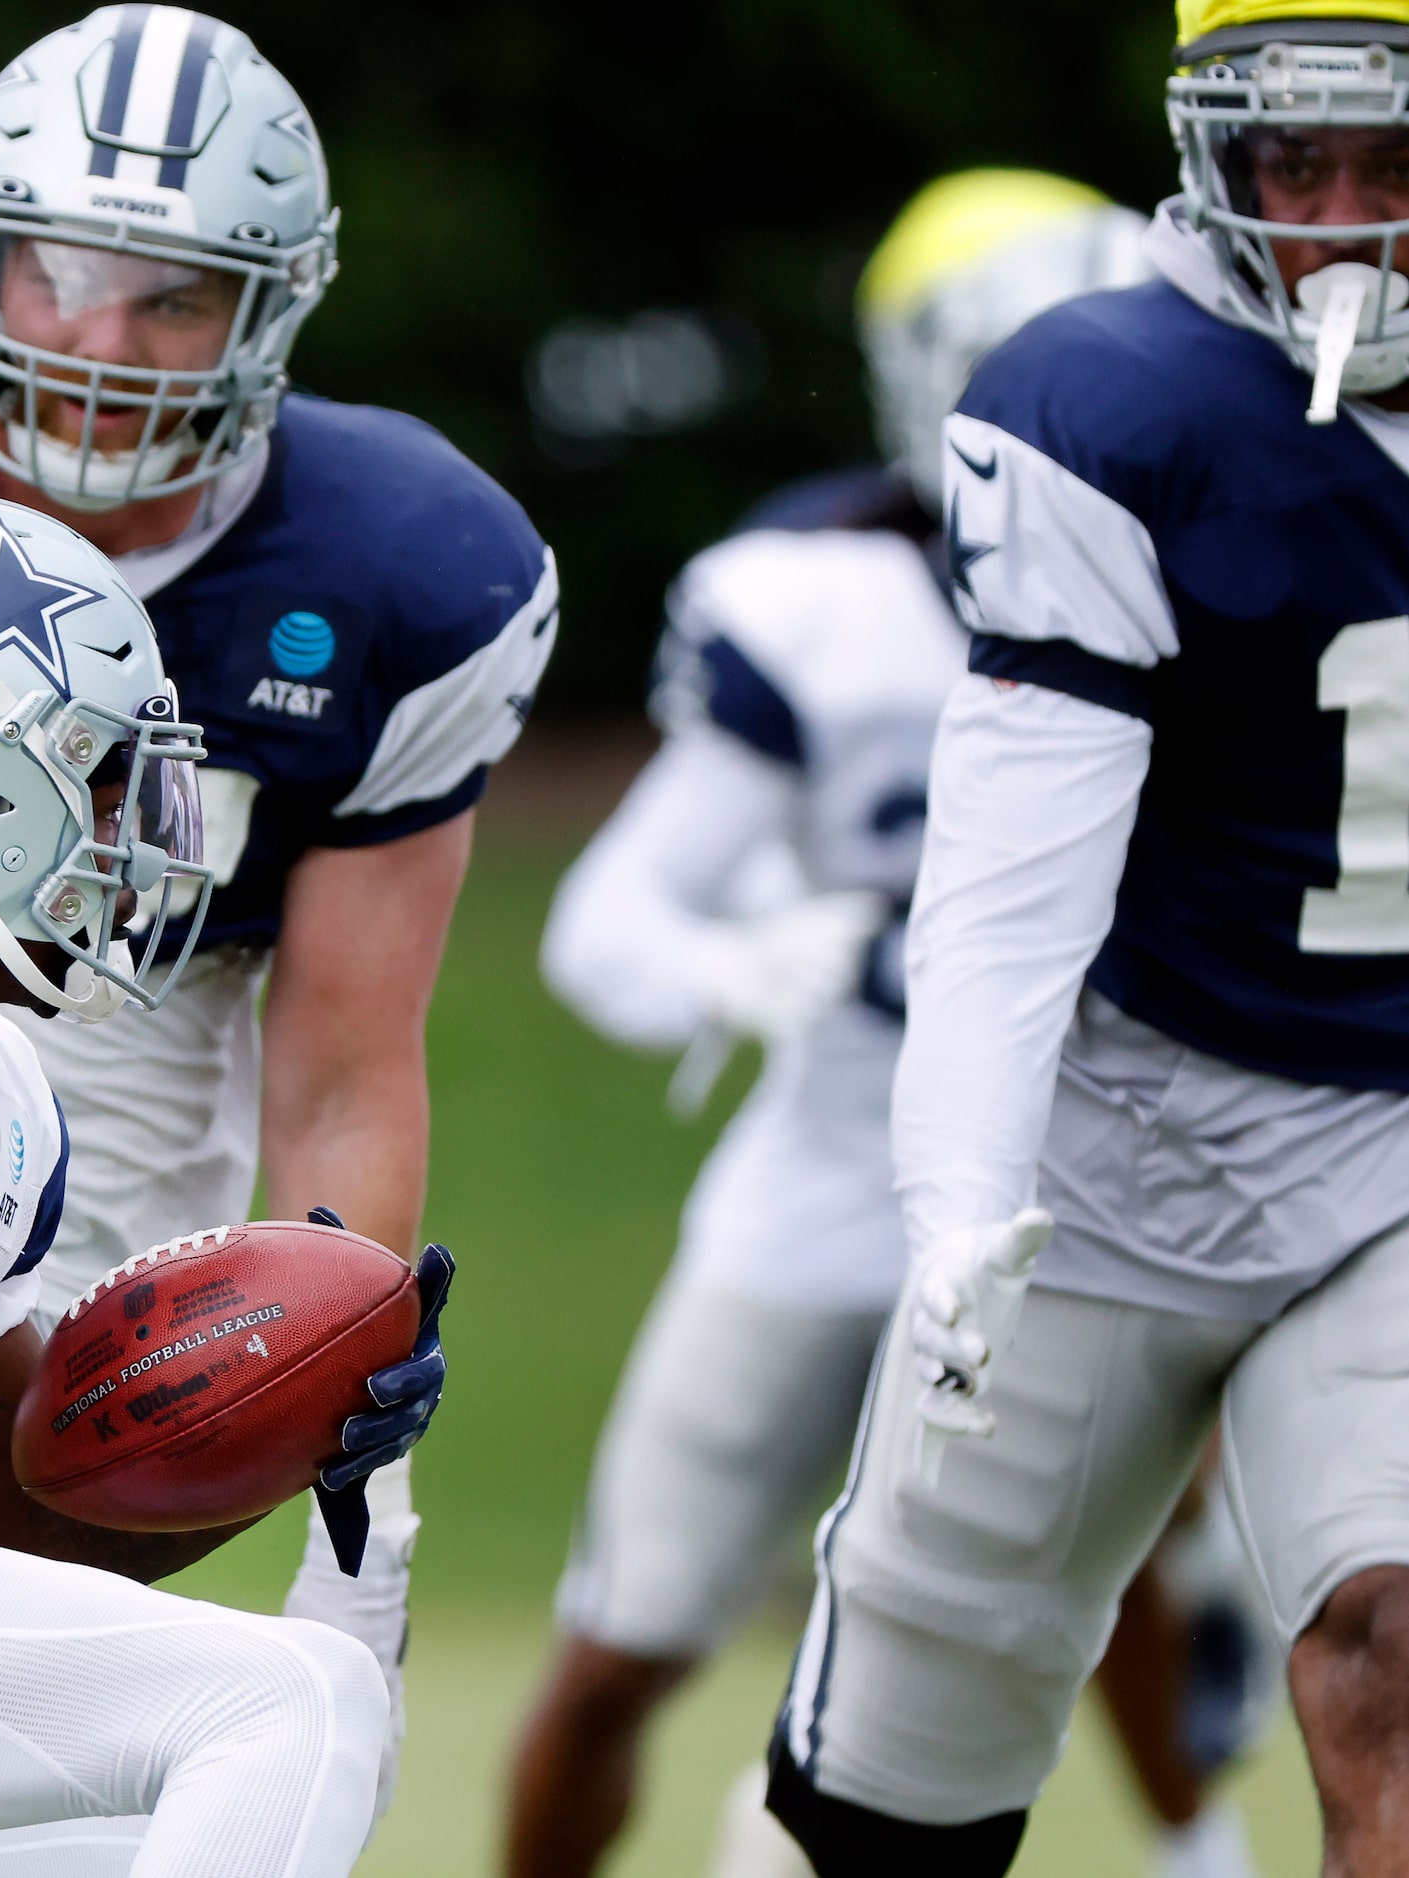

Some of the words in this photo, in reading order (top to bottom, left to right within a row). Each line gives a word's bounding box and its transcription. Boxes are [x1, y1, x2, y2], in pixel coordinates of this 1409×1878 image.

[247, 677, 333, 720] AT&T
[52, 1379, 117, 1435] NATIONAL
[120, 1331, 208, 1383] FOOTBALL
[211, 1304, 284, 1339] LEAGUE
[92, 1411, 121, 1443] K
